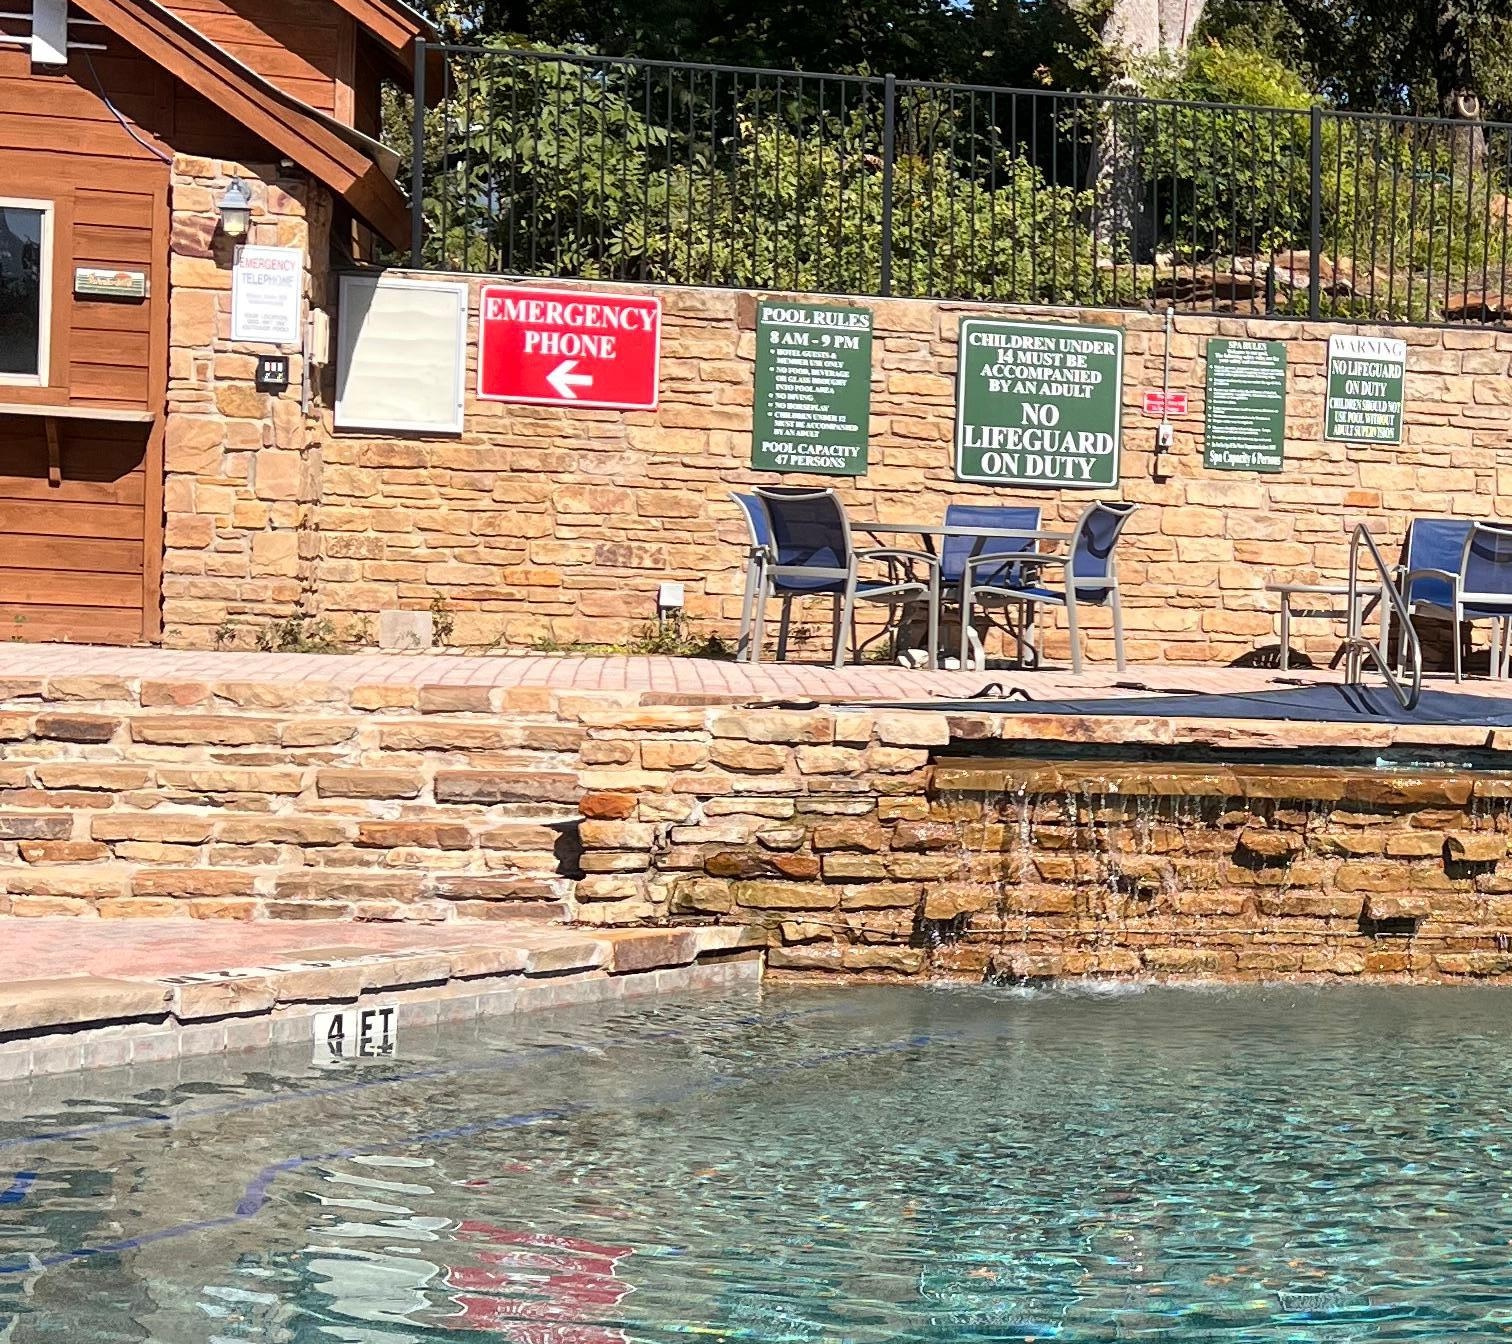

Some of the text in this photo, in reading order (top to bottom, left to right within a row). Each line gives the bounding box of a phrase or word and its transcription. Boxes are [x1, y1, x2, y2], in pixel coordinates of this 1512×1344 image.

[239, 257, 296, 272] EMERGENCY
[241, 273, 294, 287] TELEPHONE
[485, 297, 657, 331] EMERGENCY
[762, 307, 870, 327] POOL RULES
[523, 330, 616, 359] PHONE
[770, 331, 780, 344] 8
[781, 332, 809, 346] AM
[821, 335, 831, 347] 9
[834, 336, 860, 350] PM
[969, 332, 1115, 356] CHILDREN UNDER
[1228, 341, 1267, 351] SPA RULES
[1334, 338, 1402, 357] WARNING
[776, 349, 801, 357] HOTEL
[802, 350, 829, 359] GUESTS
[997, 349, 1088, 368] 14 MUST BE
[776, 357, 808, 366] MEMBER
[824, 361, 844, 369] ONLY
[1332, 359, 1402, 379] NO LIFEGUARD
[788, 376, 811, 384] GLASS
[812, 378, 847, 386] BROUGHT
[811, 369, 850, 378] BEVERAGE
[980, 363, 1102, 384] ACCOMPANIED
[775, 384, 835, 394] INTO POOL AREA
[988, 378, 1094, 399] BY AN ADULT
[1345, 380, 1388, 397] ON DUTY
[787, 393, 814, 401] DIVING
[1330, 397, 1402, 413] CHILDREN SHOULD NOT
[787, 403, 830, 412] HORSEPLAY
[1020, 402, 1060, 427] NO
[774, 411, 812, 420] CHILDREN
[813, 413, 838, 422] UNDER
[1334, 410, 1395, 425] USE POOL WITHOUT
[796, 430, 820, 438] ADULT
[806, 422, 859, 431] ACCOMPANIED
[1333, 424, 1395, 438] ADULT SUPERVISION
[963, 424, 1114, 455] LIFEGUARD
[762, 441, 860, 457] POOL CAPACITY
[775, 454, 845, 468] 47 PERSONS
[981, 451, 1097, 479] ON DUTY
[1209, 450, 1281, 467] Spa Capacity 6 Persons
[327, 1007, 394, 1040] 4 FT
